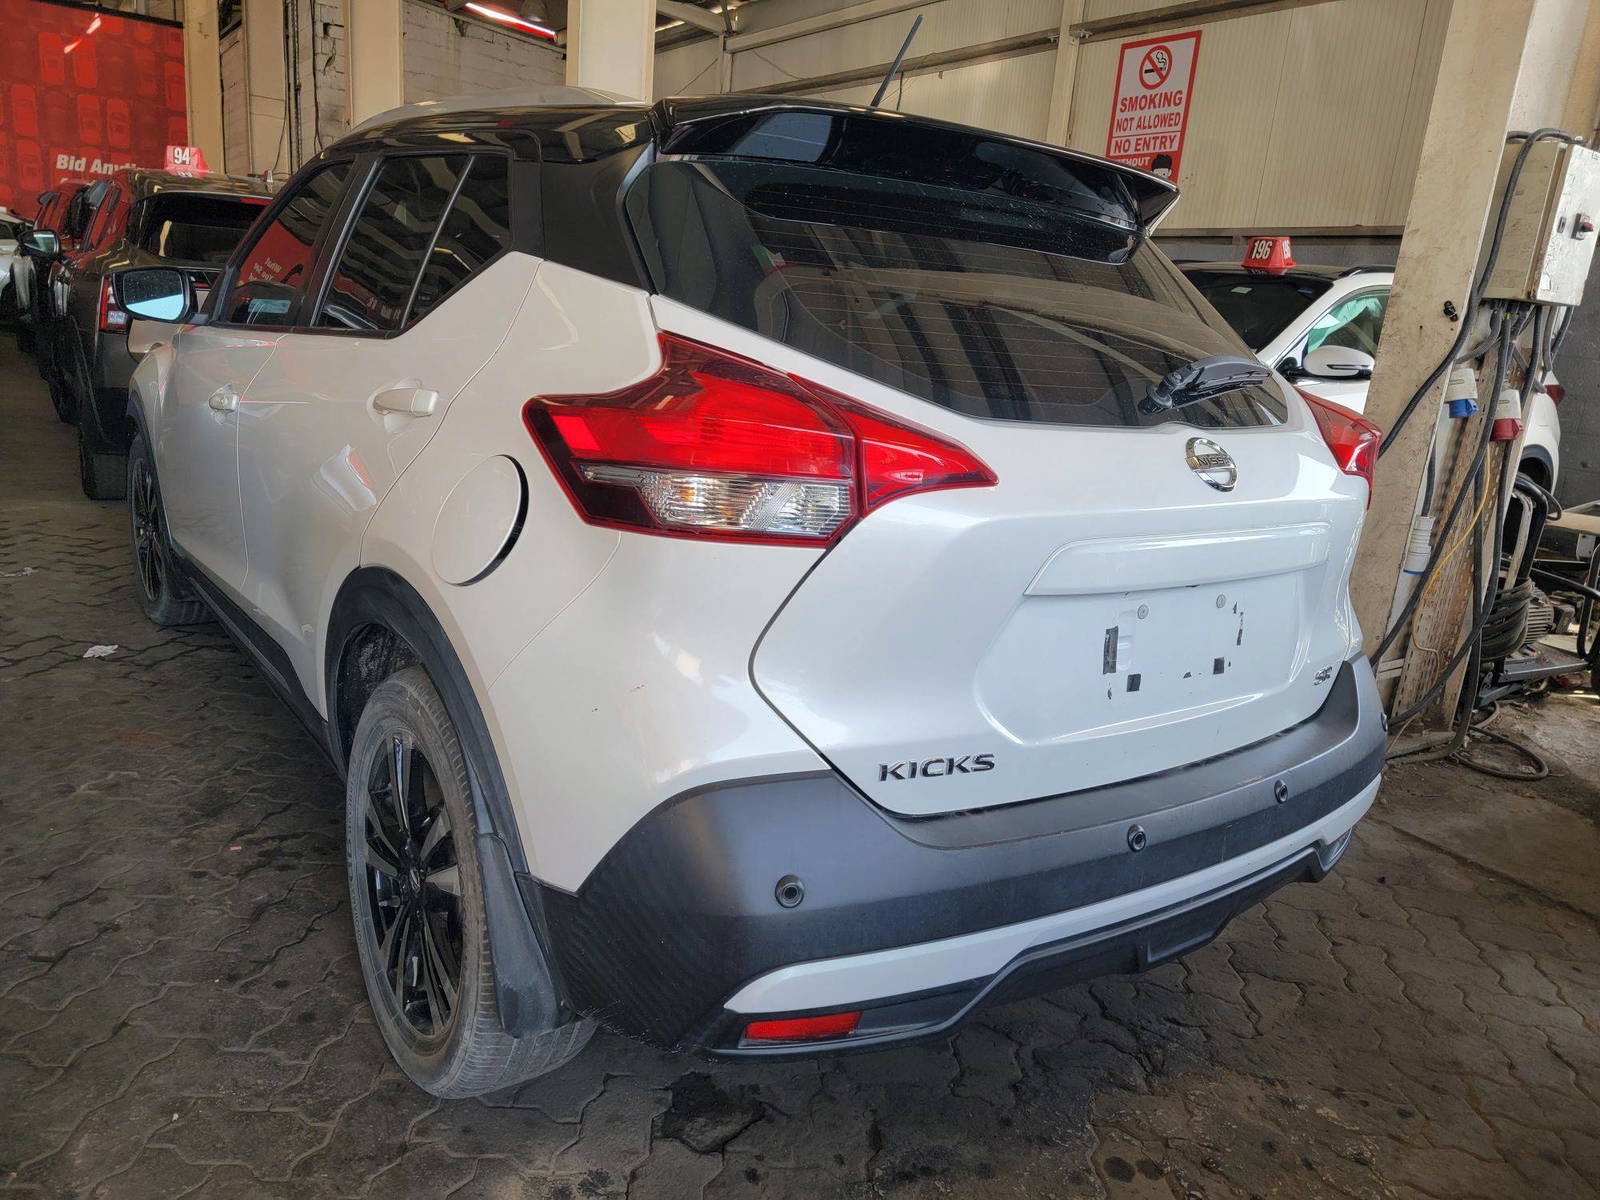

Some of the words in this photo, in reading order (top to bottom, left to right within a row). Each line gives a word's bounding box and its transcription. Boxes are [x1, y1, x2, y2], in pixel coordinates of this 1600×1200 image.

[1120, 90, 1183, 113] SMOKING
[1115, 117, 1134, 132] NOT
[1136, 112, 1181, 130] ALLOWED
[1114, 139, 1131, 153] NO
[1135, 134, 1176, 152] ENTRY
[56, 154, 87, 172] Bid
[173, 147, 190, 165] 94
[1251, 240, 1273, 260] 196
[878, 753, 995, 782] KICKS
